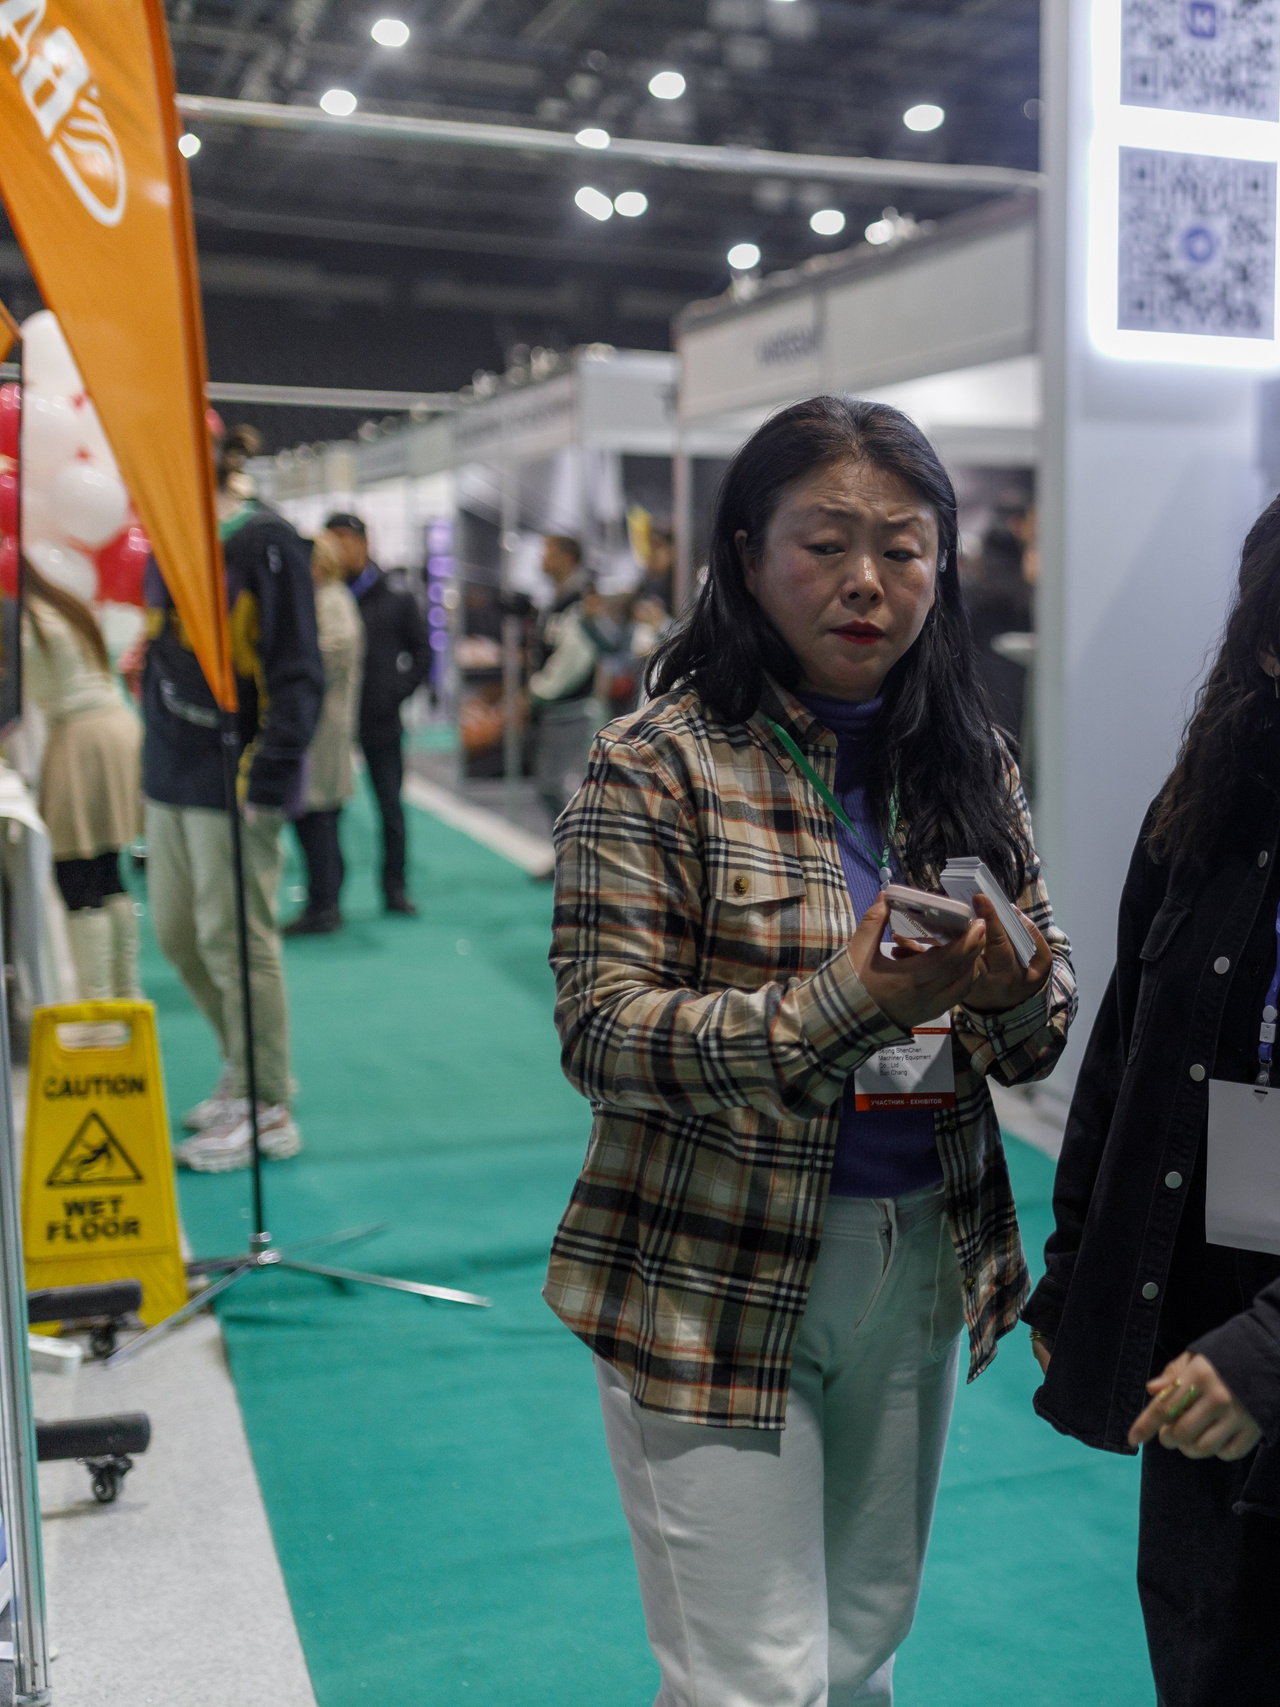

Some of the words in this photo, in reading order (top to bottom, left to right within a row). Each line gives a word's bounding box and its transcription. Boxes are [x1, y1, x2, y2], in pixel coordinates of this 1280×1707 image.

[43, 1075, 146, 1100] CAUTION
[64, 1195, 122, 1216] WET
[47, 1218, 140, 1242] FLOOR
